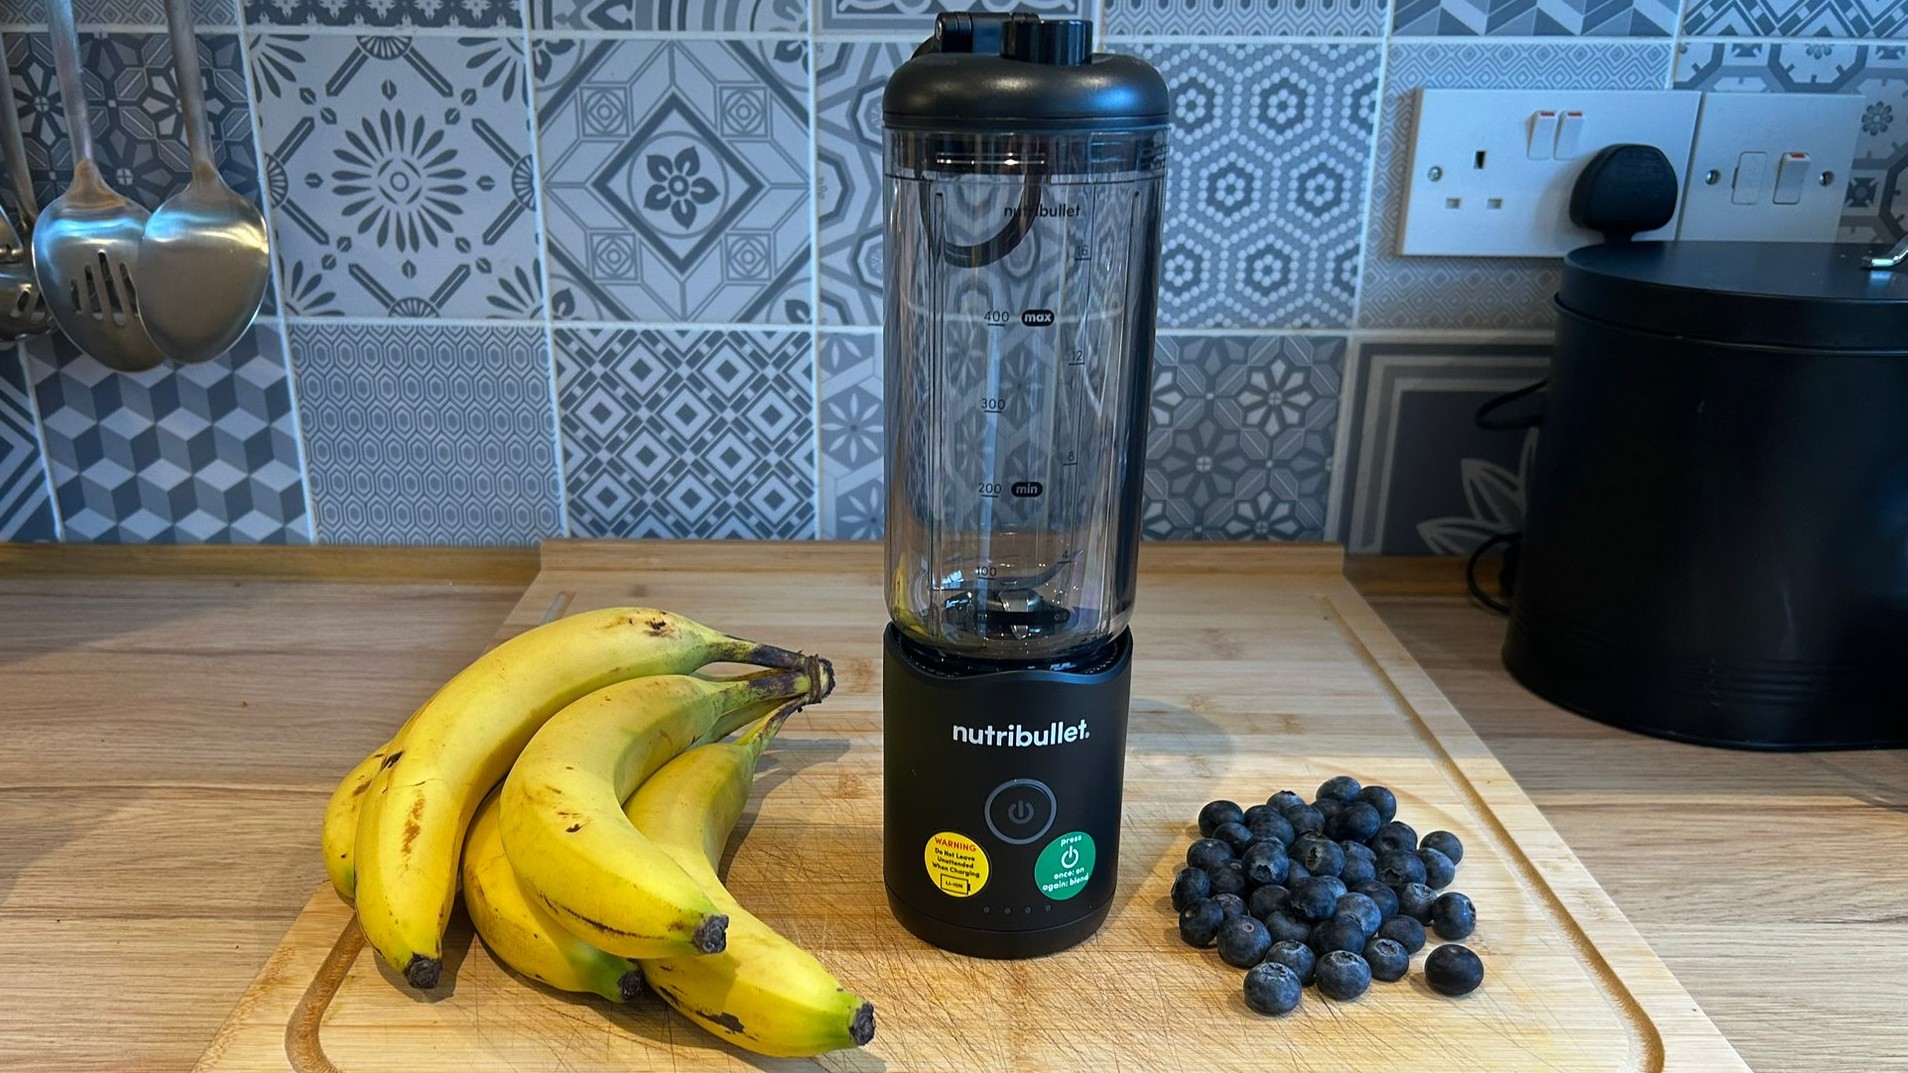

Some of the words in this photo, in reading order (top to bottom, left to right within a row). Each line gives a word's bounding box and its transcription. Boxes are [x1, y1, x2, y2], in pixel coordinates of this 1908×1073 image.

[984, 311, 1009, 322] 400
[1023, 312, 1052, 324] max
[1072, 350, 1083, 362] 12
[981, 399, 1005, 410] 300
[1068, 451, 1075, 461] 8
[979, 483, 1001, 494] 200
[1014, 483, 1039, 495] min
[976, 566, 997, 577] 100
[935, 837, 976, 851] WARNING
[1061, 835, 1082, 847] press
[935, 847, 943, 855] Do
[944, 850, 955, 858] Not
[956, 853, 975, 861] Leave
[937, 857, 974, 869] Unattended
[932, 861, 948, 871] When
[950, 867, 980, 878] Charging
[1054, 870, 1075, 880] once:
[1042, 880, 1068, 892] again:
[1070, 872, 1089, 886] blend
